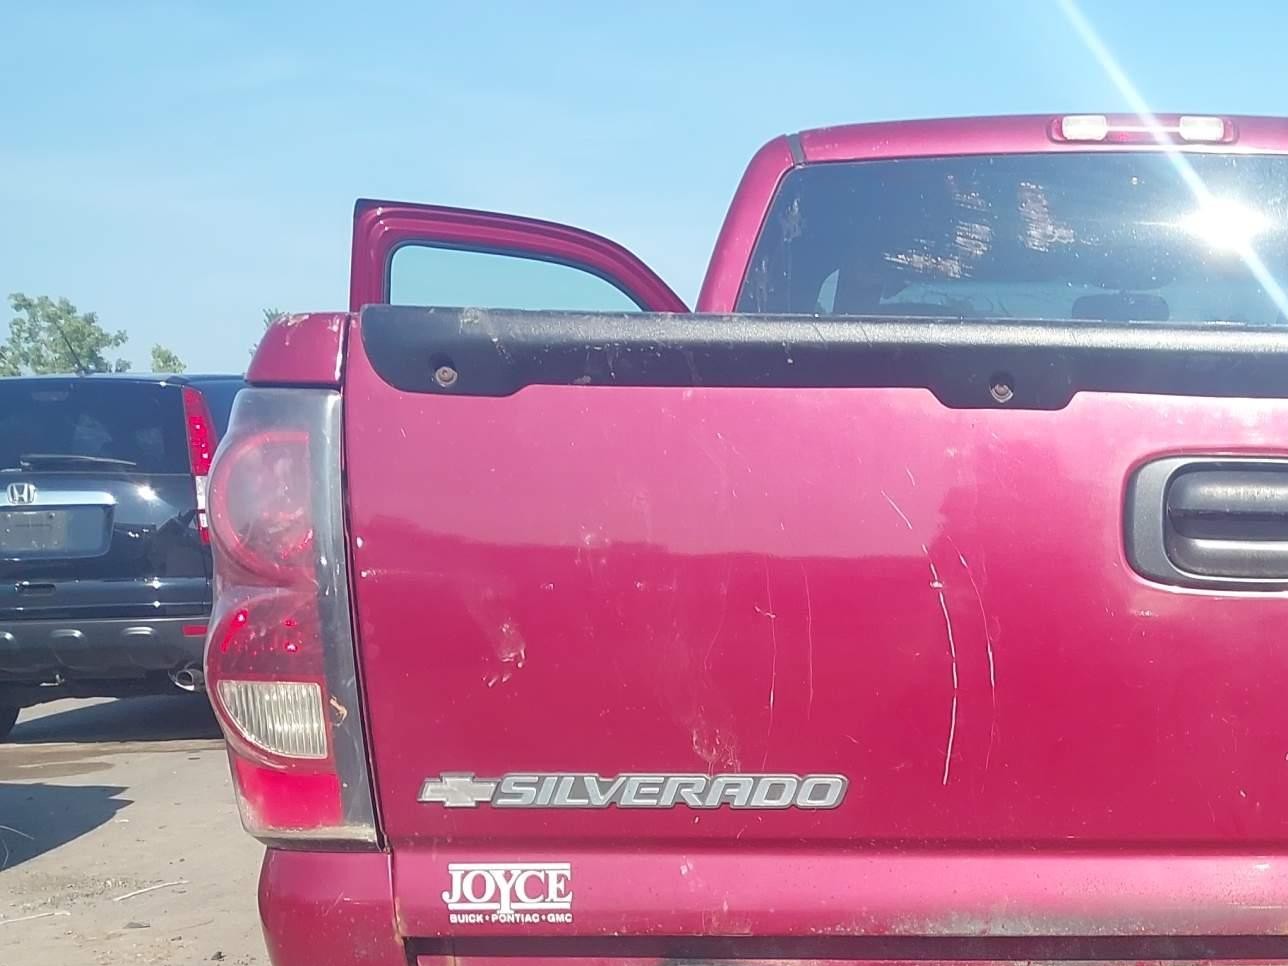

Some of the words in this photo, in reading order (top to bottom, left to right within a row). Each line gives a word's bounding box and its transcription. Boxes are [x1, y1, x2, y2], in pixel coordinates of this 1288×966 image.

[497, 775, 847, 808] SILVERADO
[441, 869, 573, 914] JOYCE
[449, 913, 484, 924] BUICK
[491, 913, 540, 924] PONTIAC
[547, 913, 573, 924] GMC
